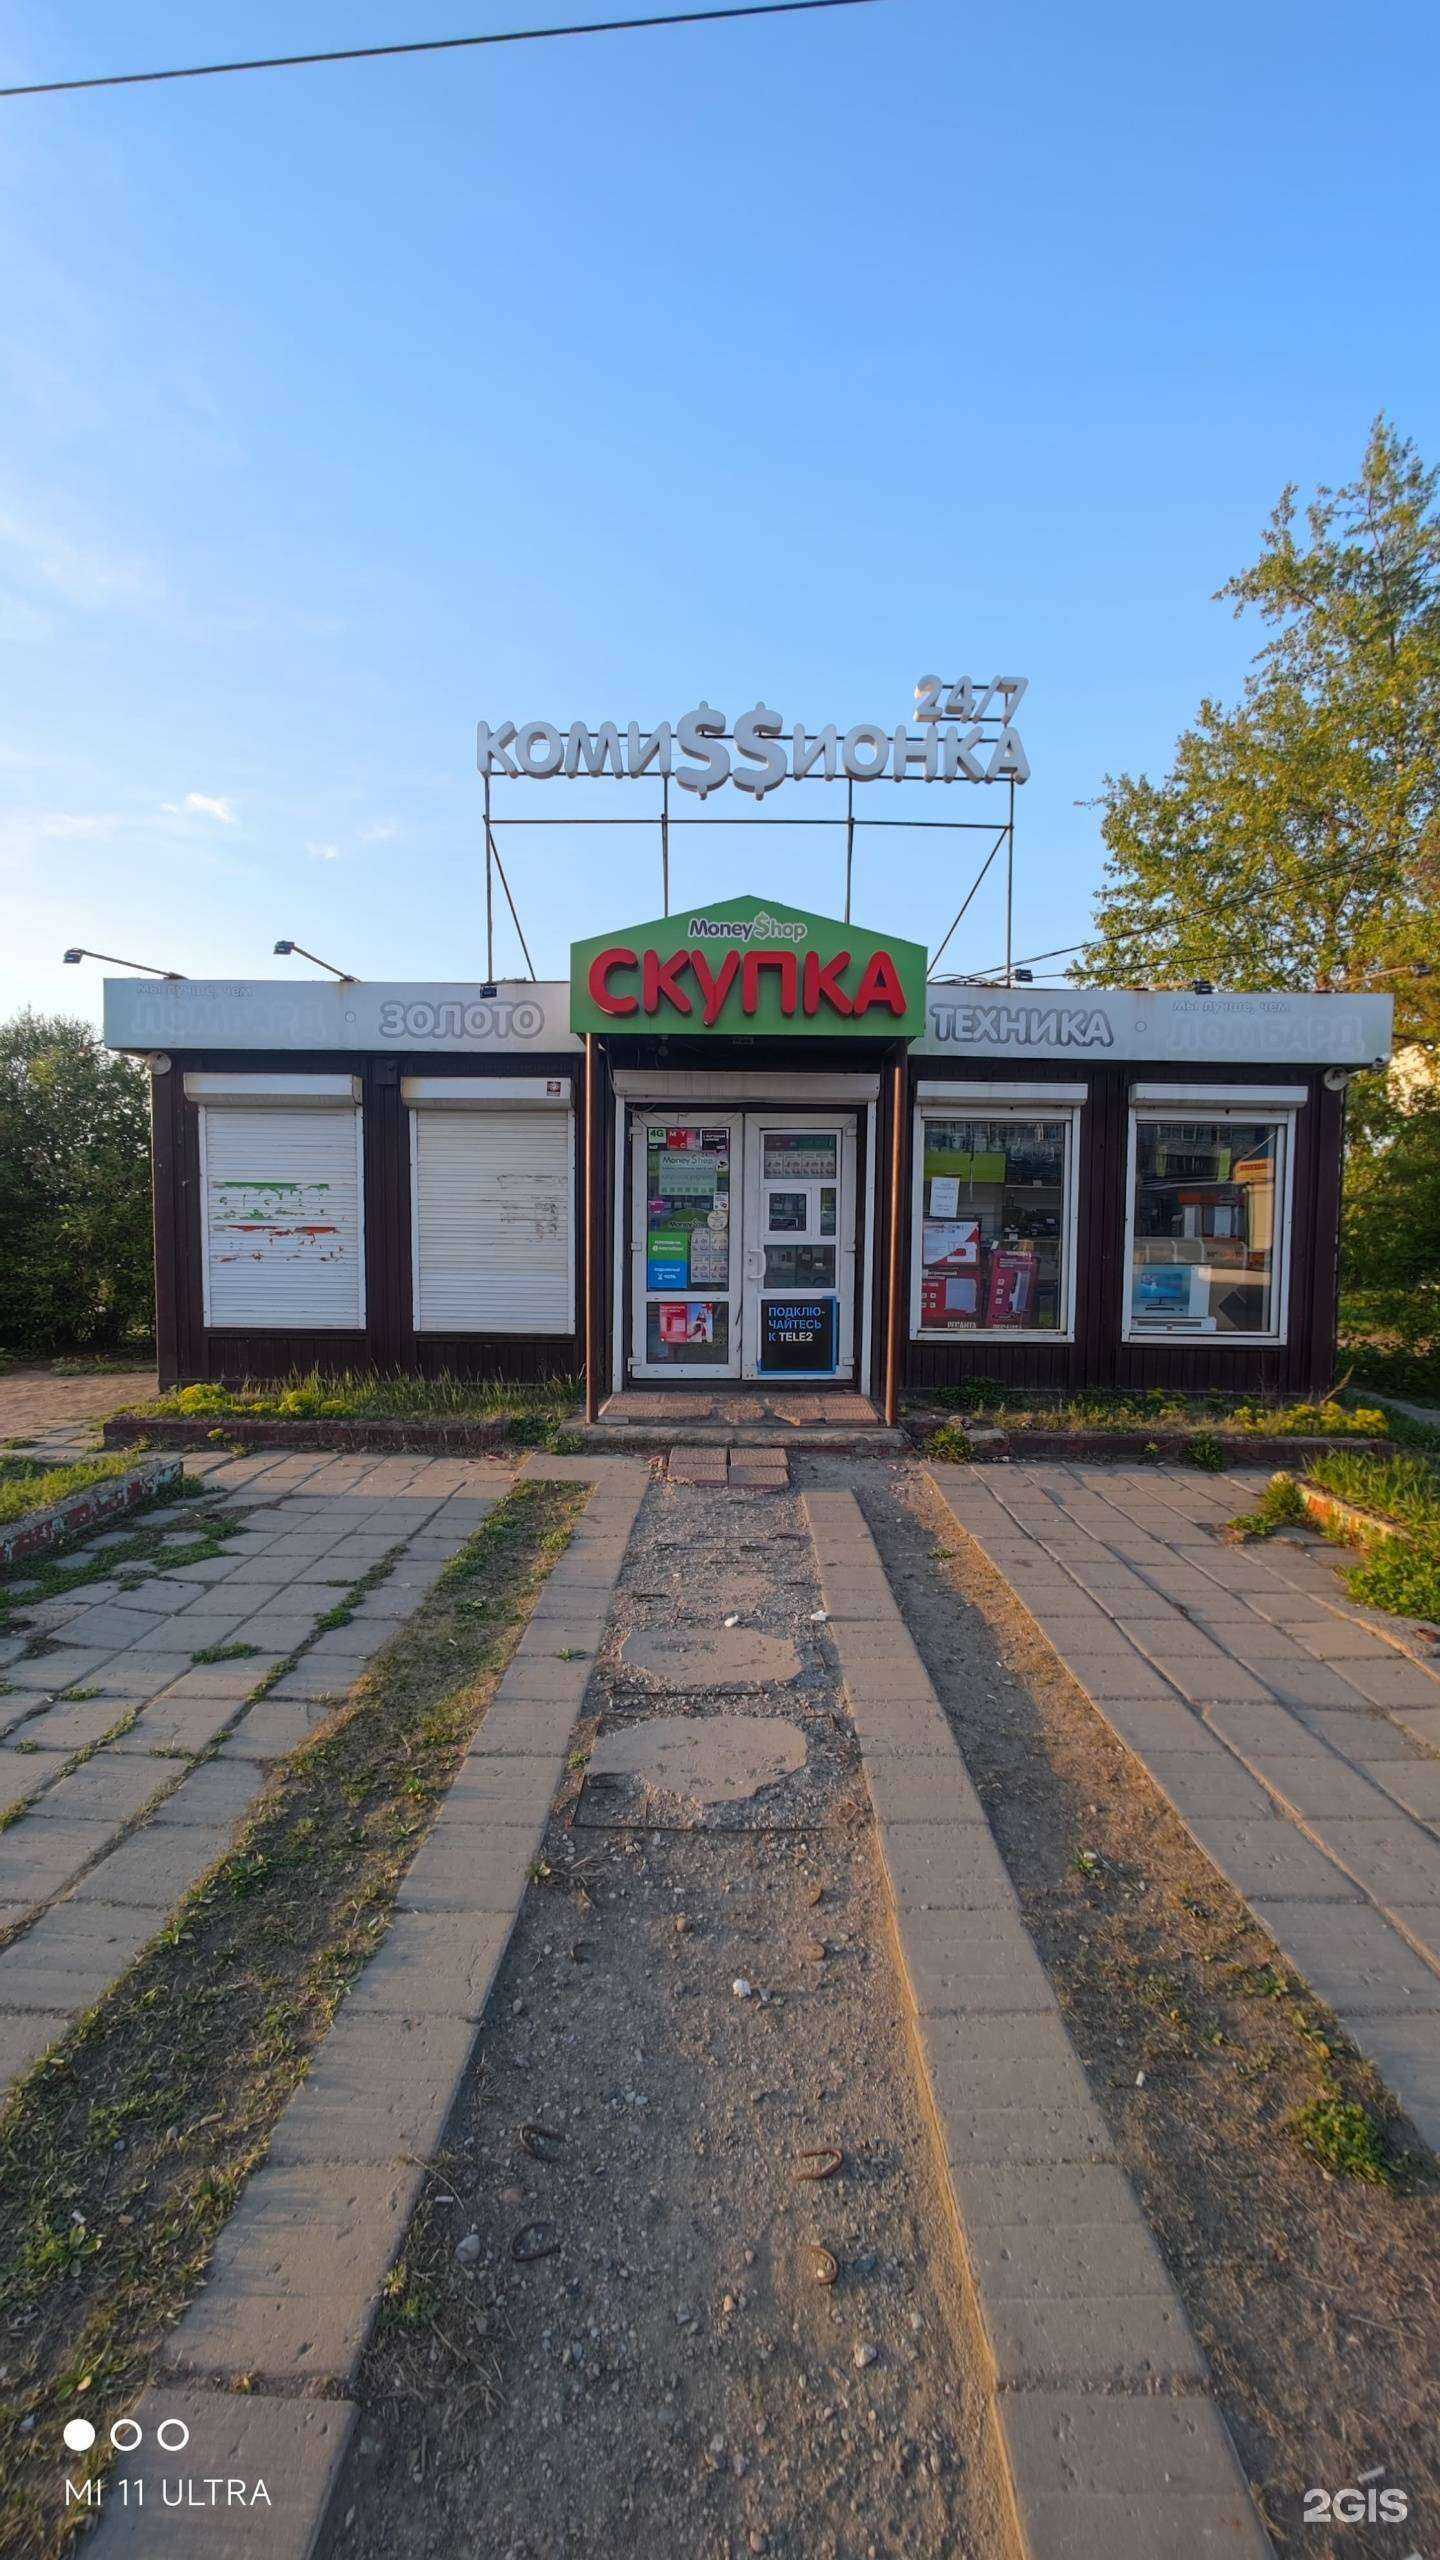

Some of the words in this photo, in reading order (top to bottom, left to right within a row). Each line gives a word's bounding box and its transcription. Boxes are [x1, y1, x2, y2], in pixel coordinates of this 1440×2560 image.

[914, 674, 1030, 725] 24/7
[588, 947, 907, 1027] СКУПКА
[380, 1001, 545, 1038] ЗОЛОТО
[929, 1004, 1114, 1047] ТЕХНИКА
[649, 1129, 664, 1137] 4G
[768, 1306, 825, 1318] ПОДКЛЮ-
[768, 1318, 822, 1329] ЧАЙТЕСЬ
[768, 1332, 777, 1341] К
[779, 1332, 813, 1342] TELE2
